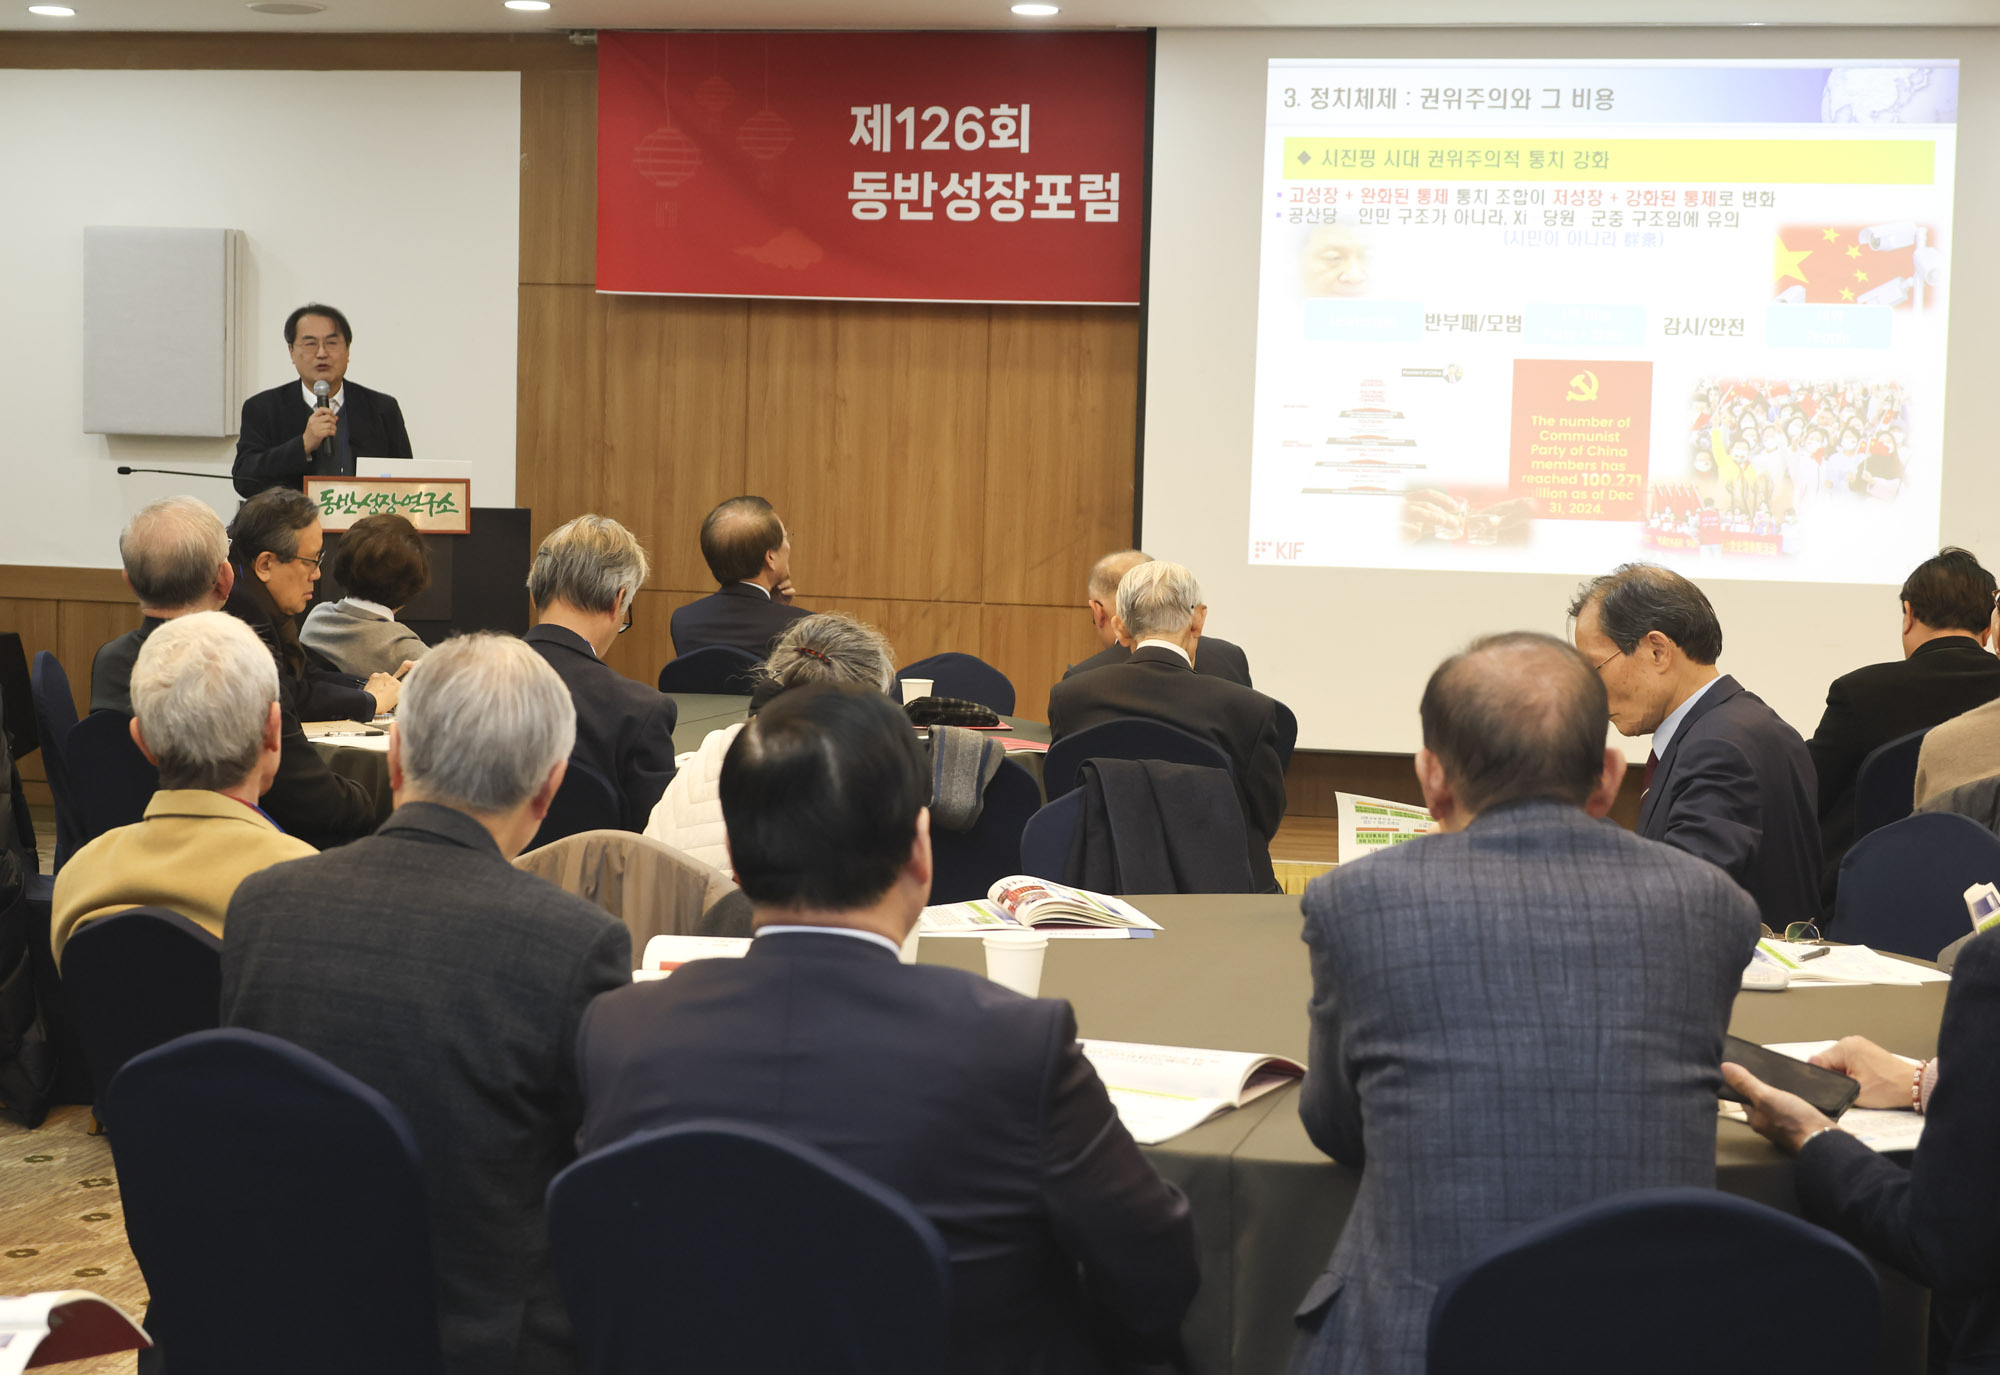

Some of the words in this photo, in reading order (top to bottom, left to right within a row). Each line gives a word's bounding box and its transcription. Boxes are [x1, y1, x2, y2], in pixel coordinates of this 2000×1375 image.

[1283, 87, 1300, 108] 3.
[1310, 87, 1397, 110] 정치체제
[1419, 87, 1531, 111] 권위주의와
[1540, 88, 1562, 110] 그
[1571, 87, 1615, 112] 비용
[849, 103, 1031, 154] 제126회
[1321, 149, 1376, 169] 시진핑
[1384, 149, 1420, 169] 시대
[1427, 149, 1521, 169] 권위주의적
[1528, 150, 1564, 170] 통치
[1572, 150, 1610, 170] 강화
[848, 170, 1120, 223] 동반성장포럼
[1289, 186, 1339, 205] 고성장
[1360, 187, 1410, 205] 완화된
[1416, 187, 1449, 205] 통제
[1456, 188, 1489, 206] 통치
[1495, 188, 1545, 206] 조합이
[1553, 189, 1603, 207] 저성장
[1626, 189, 1676, 207] 강화된
[1683, 190, 1734, 208] 통제로
[1742, 190, 1776, 208] 변화
[1288, 207, 1338, 224] 공산당
[1359, 207, 1391, 225] 인민
[1397, 208, 1447, 226] 구조가
[1454, 208, 1508, 227] 아니라,
[1513, 209, 1528, 226] Xi
[1543, 209, 1576, 227] 당원
[1591, 209, 1624, 228] 군중
[1631, 210, 1700, 229] 구조임에
[1707, 210, 1740, 229] 유의
[1503, 229, 1560, 248] (시민이
[1567, 230, 1618, 248] 아니라
[1425, 312, 1523, 334] 반부패/모범
[1663, 316, 1745, 337] 감시/안전
[1531, 415, 1556, 427] The
[1559, 416, 1614, 428] number
[1617, 416, 1631, 428] of
[1539, 430, 1621, 442] Communist
[1531, 444, 1566, 459] Party
[1570, 444, 1584, 456] of
[1587, 445, 1628, 457] China
[1531, 460, 1597, 471] members
[1601, 460, 1627, 472] has
[1521, 474, 1578, 485] reached
[318, 489, 460, 517] 동반성장연구소
[1571, 489, 1588, 500] as
[1591, 488, 1605, 500] of
[1608, 489, 1635, 501] Dec
[1276, 540, 1305, 561] KIF
